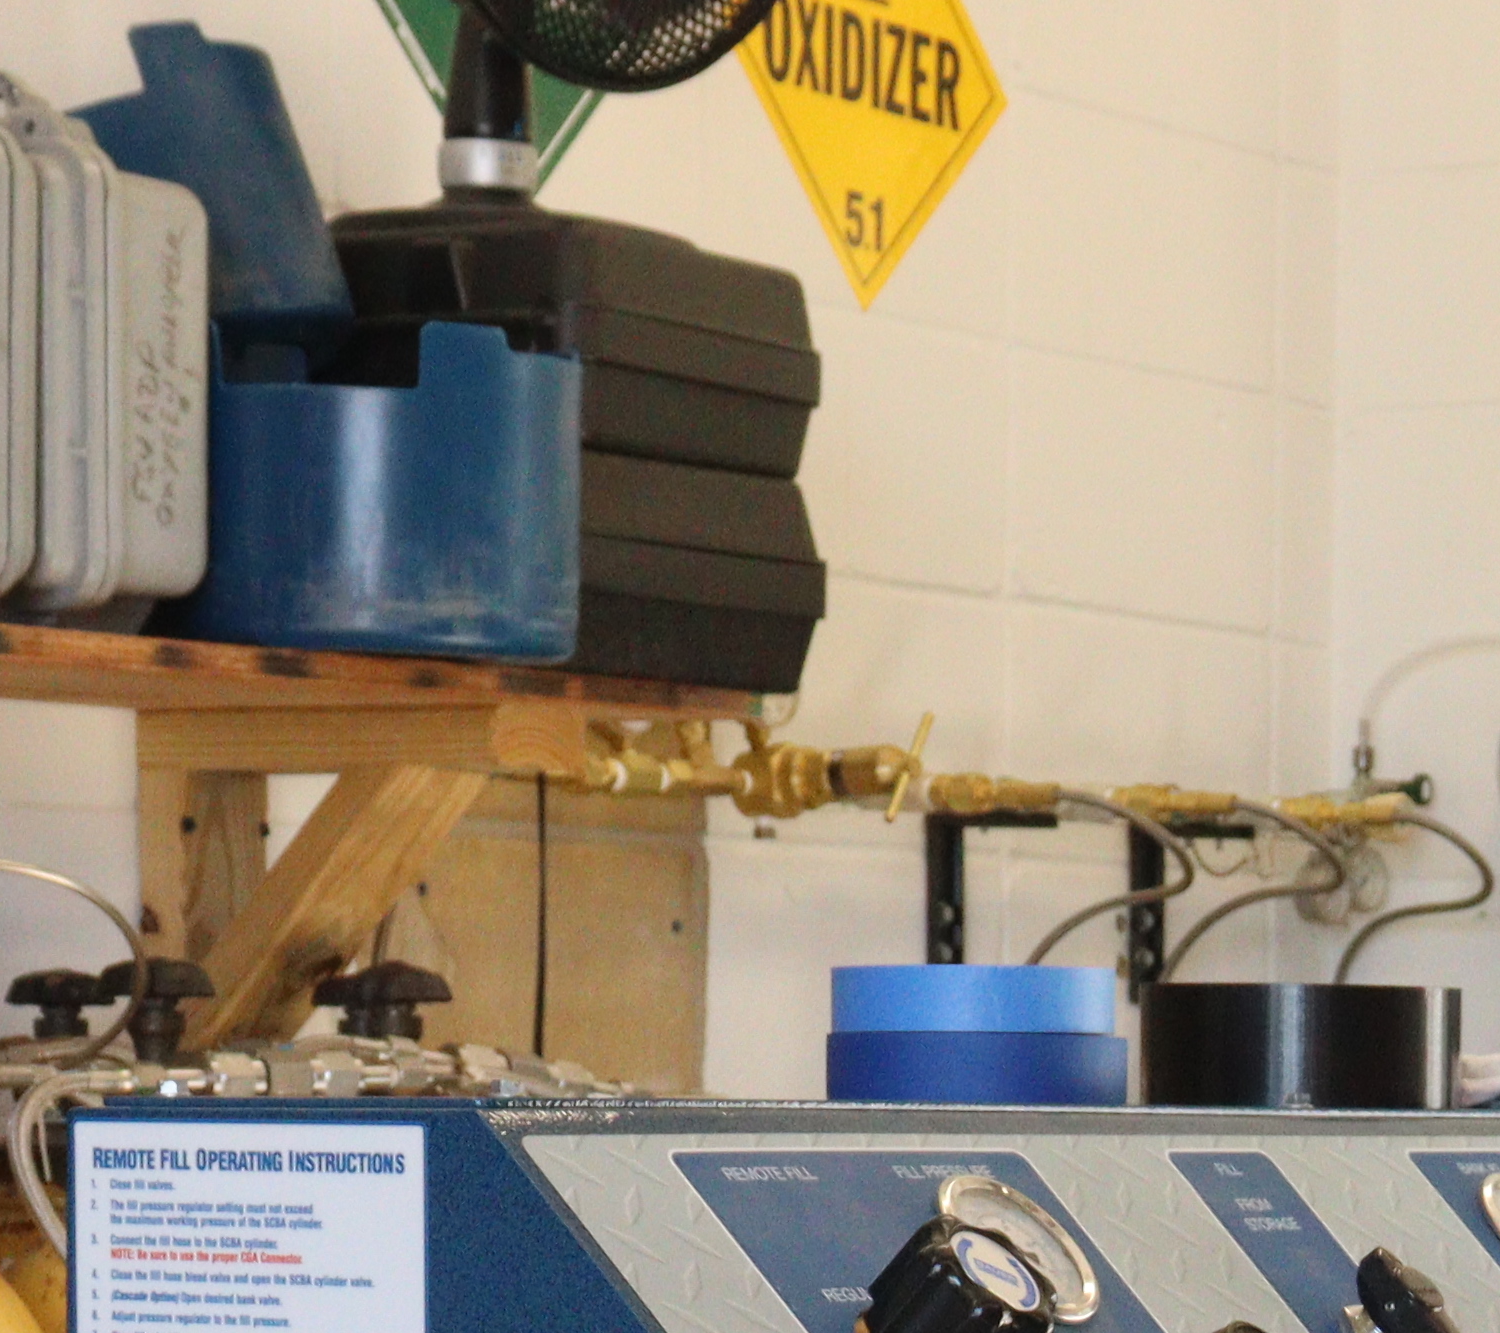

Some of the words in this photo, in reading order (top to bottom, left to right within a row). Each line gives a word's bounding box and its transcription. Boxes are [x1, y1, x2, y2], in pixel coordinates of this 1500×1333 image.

[763, 0, 961, 131] OXIDIZER
[92, 1147, 155, 1169] REMOTE
[159, 1148, 189, 1170] FILL
[195, 1149, 283, 1171] OPERATING
[288, 1151, 405, 1174] INSTRUCTIONS
[720, 1166, 785, 1182] REMOTE
[783, 1166, 819, 1181] FILL
[891, 1164, 925, 1180] FILL
